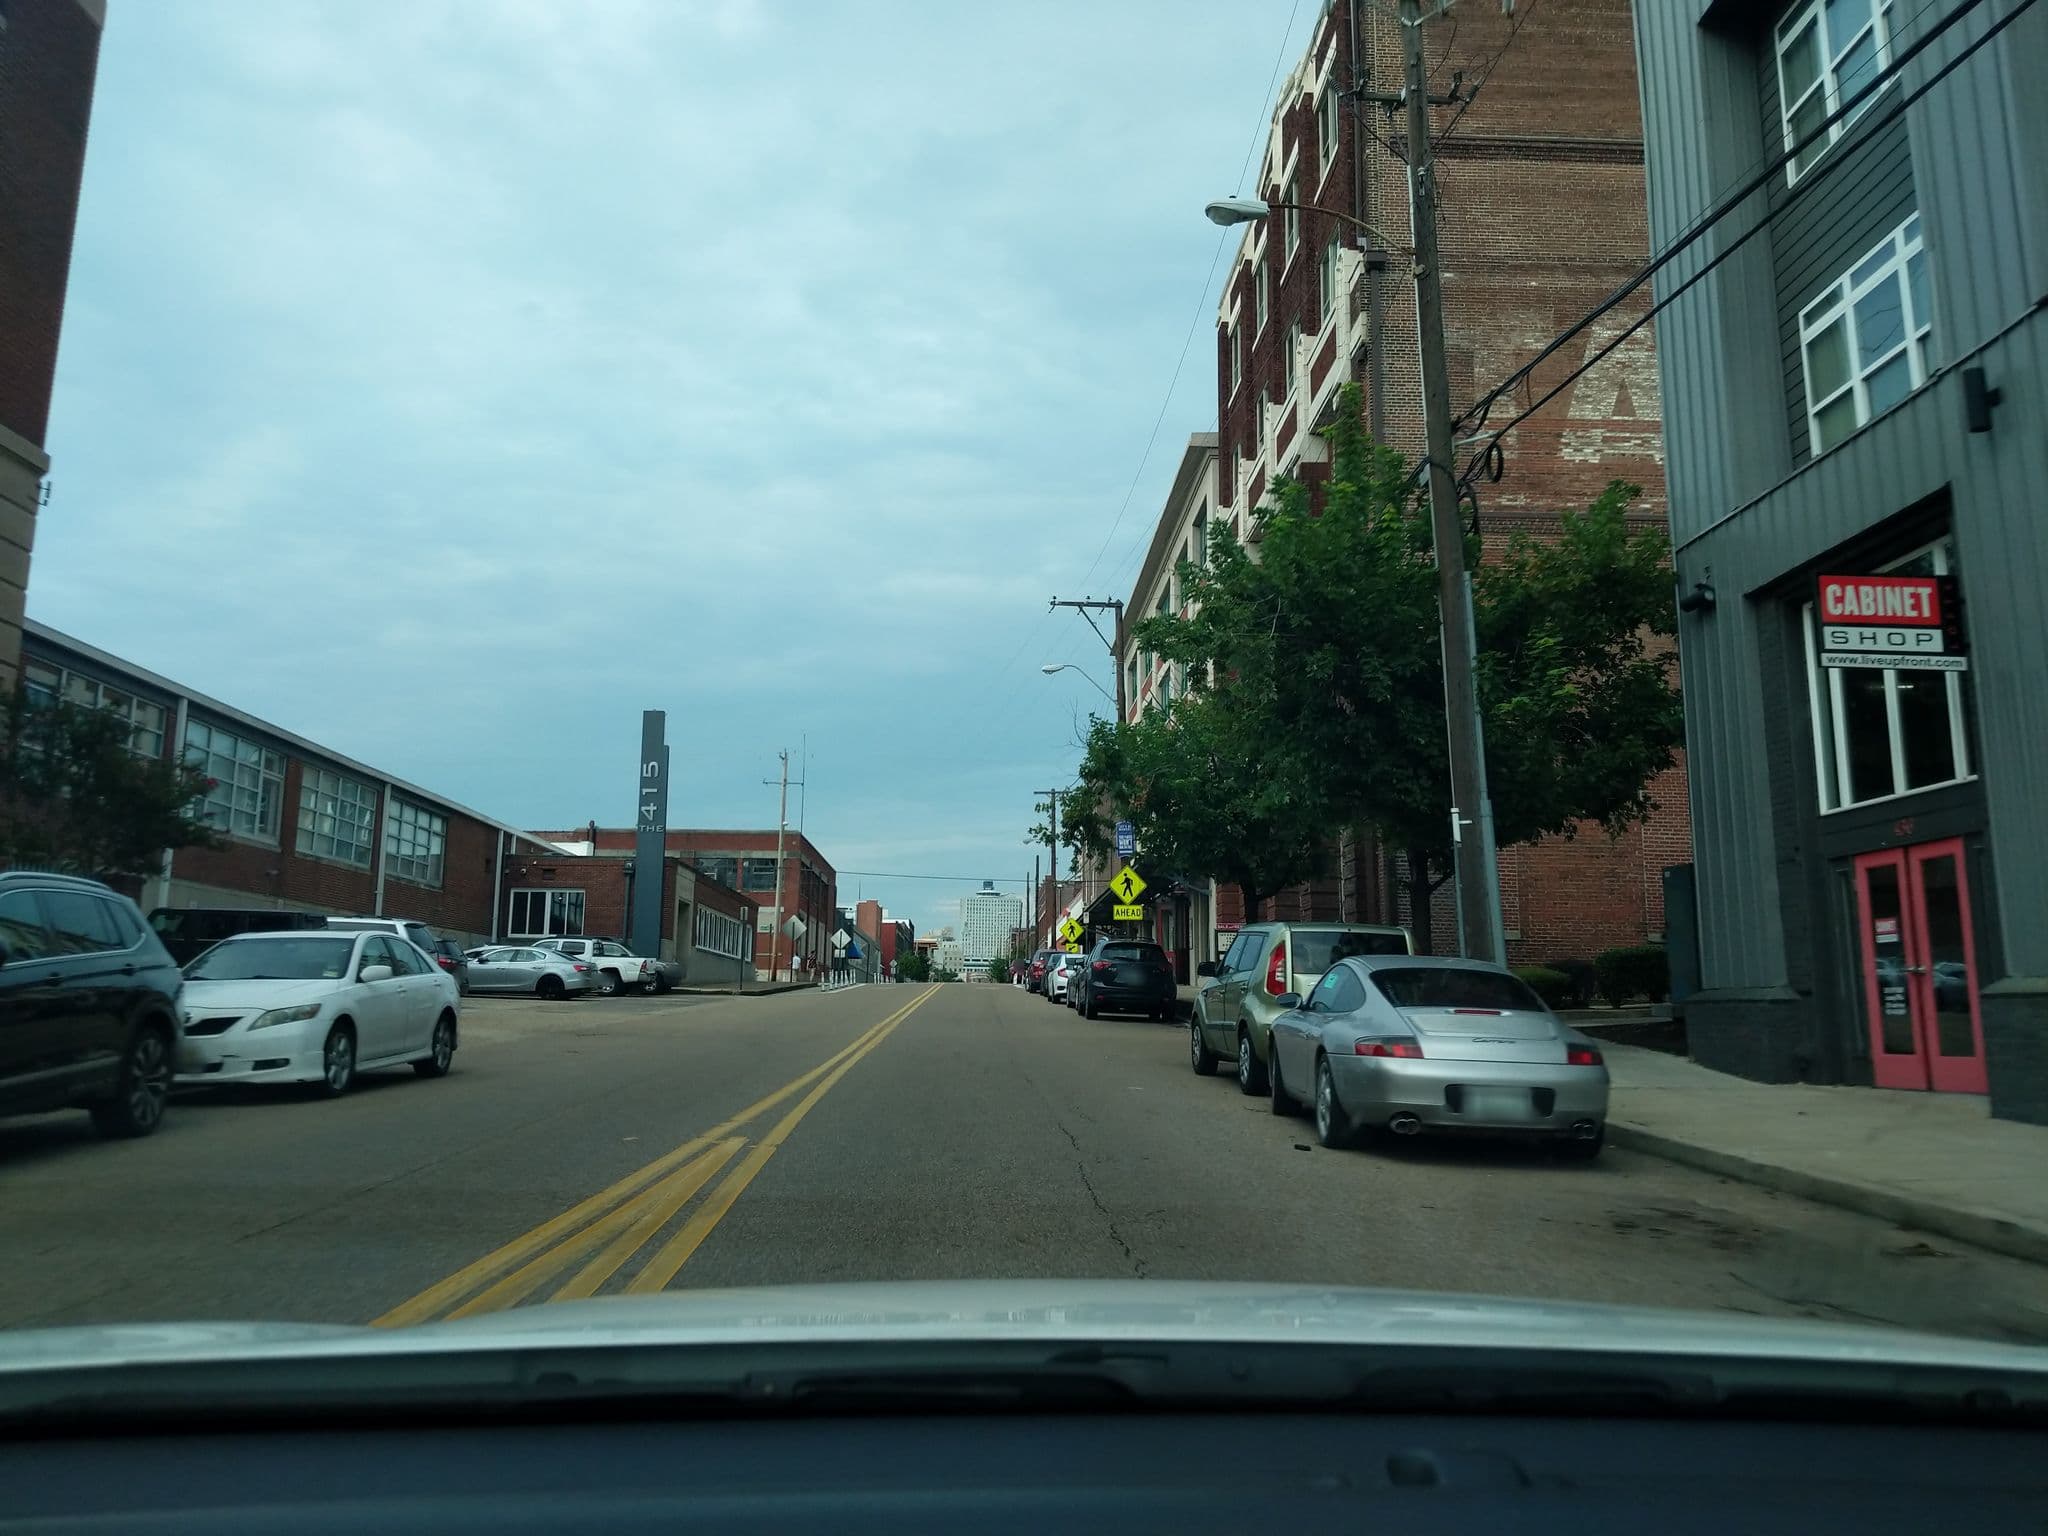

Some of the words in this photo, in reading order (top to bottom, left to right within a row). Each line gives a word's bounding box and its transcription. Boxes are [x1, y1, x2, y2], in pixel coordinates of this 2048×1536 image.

[1826, 584, 1932, 617] CABINET
[1831, 631, 1933, 646] SHOP
[1826, 654, 1963, 668] www.liveupfront.com
[641, 761, 659, 821] 415
[1115, 908, 1141, 918] AHEAD
